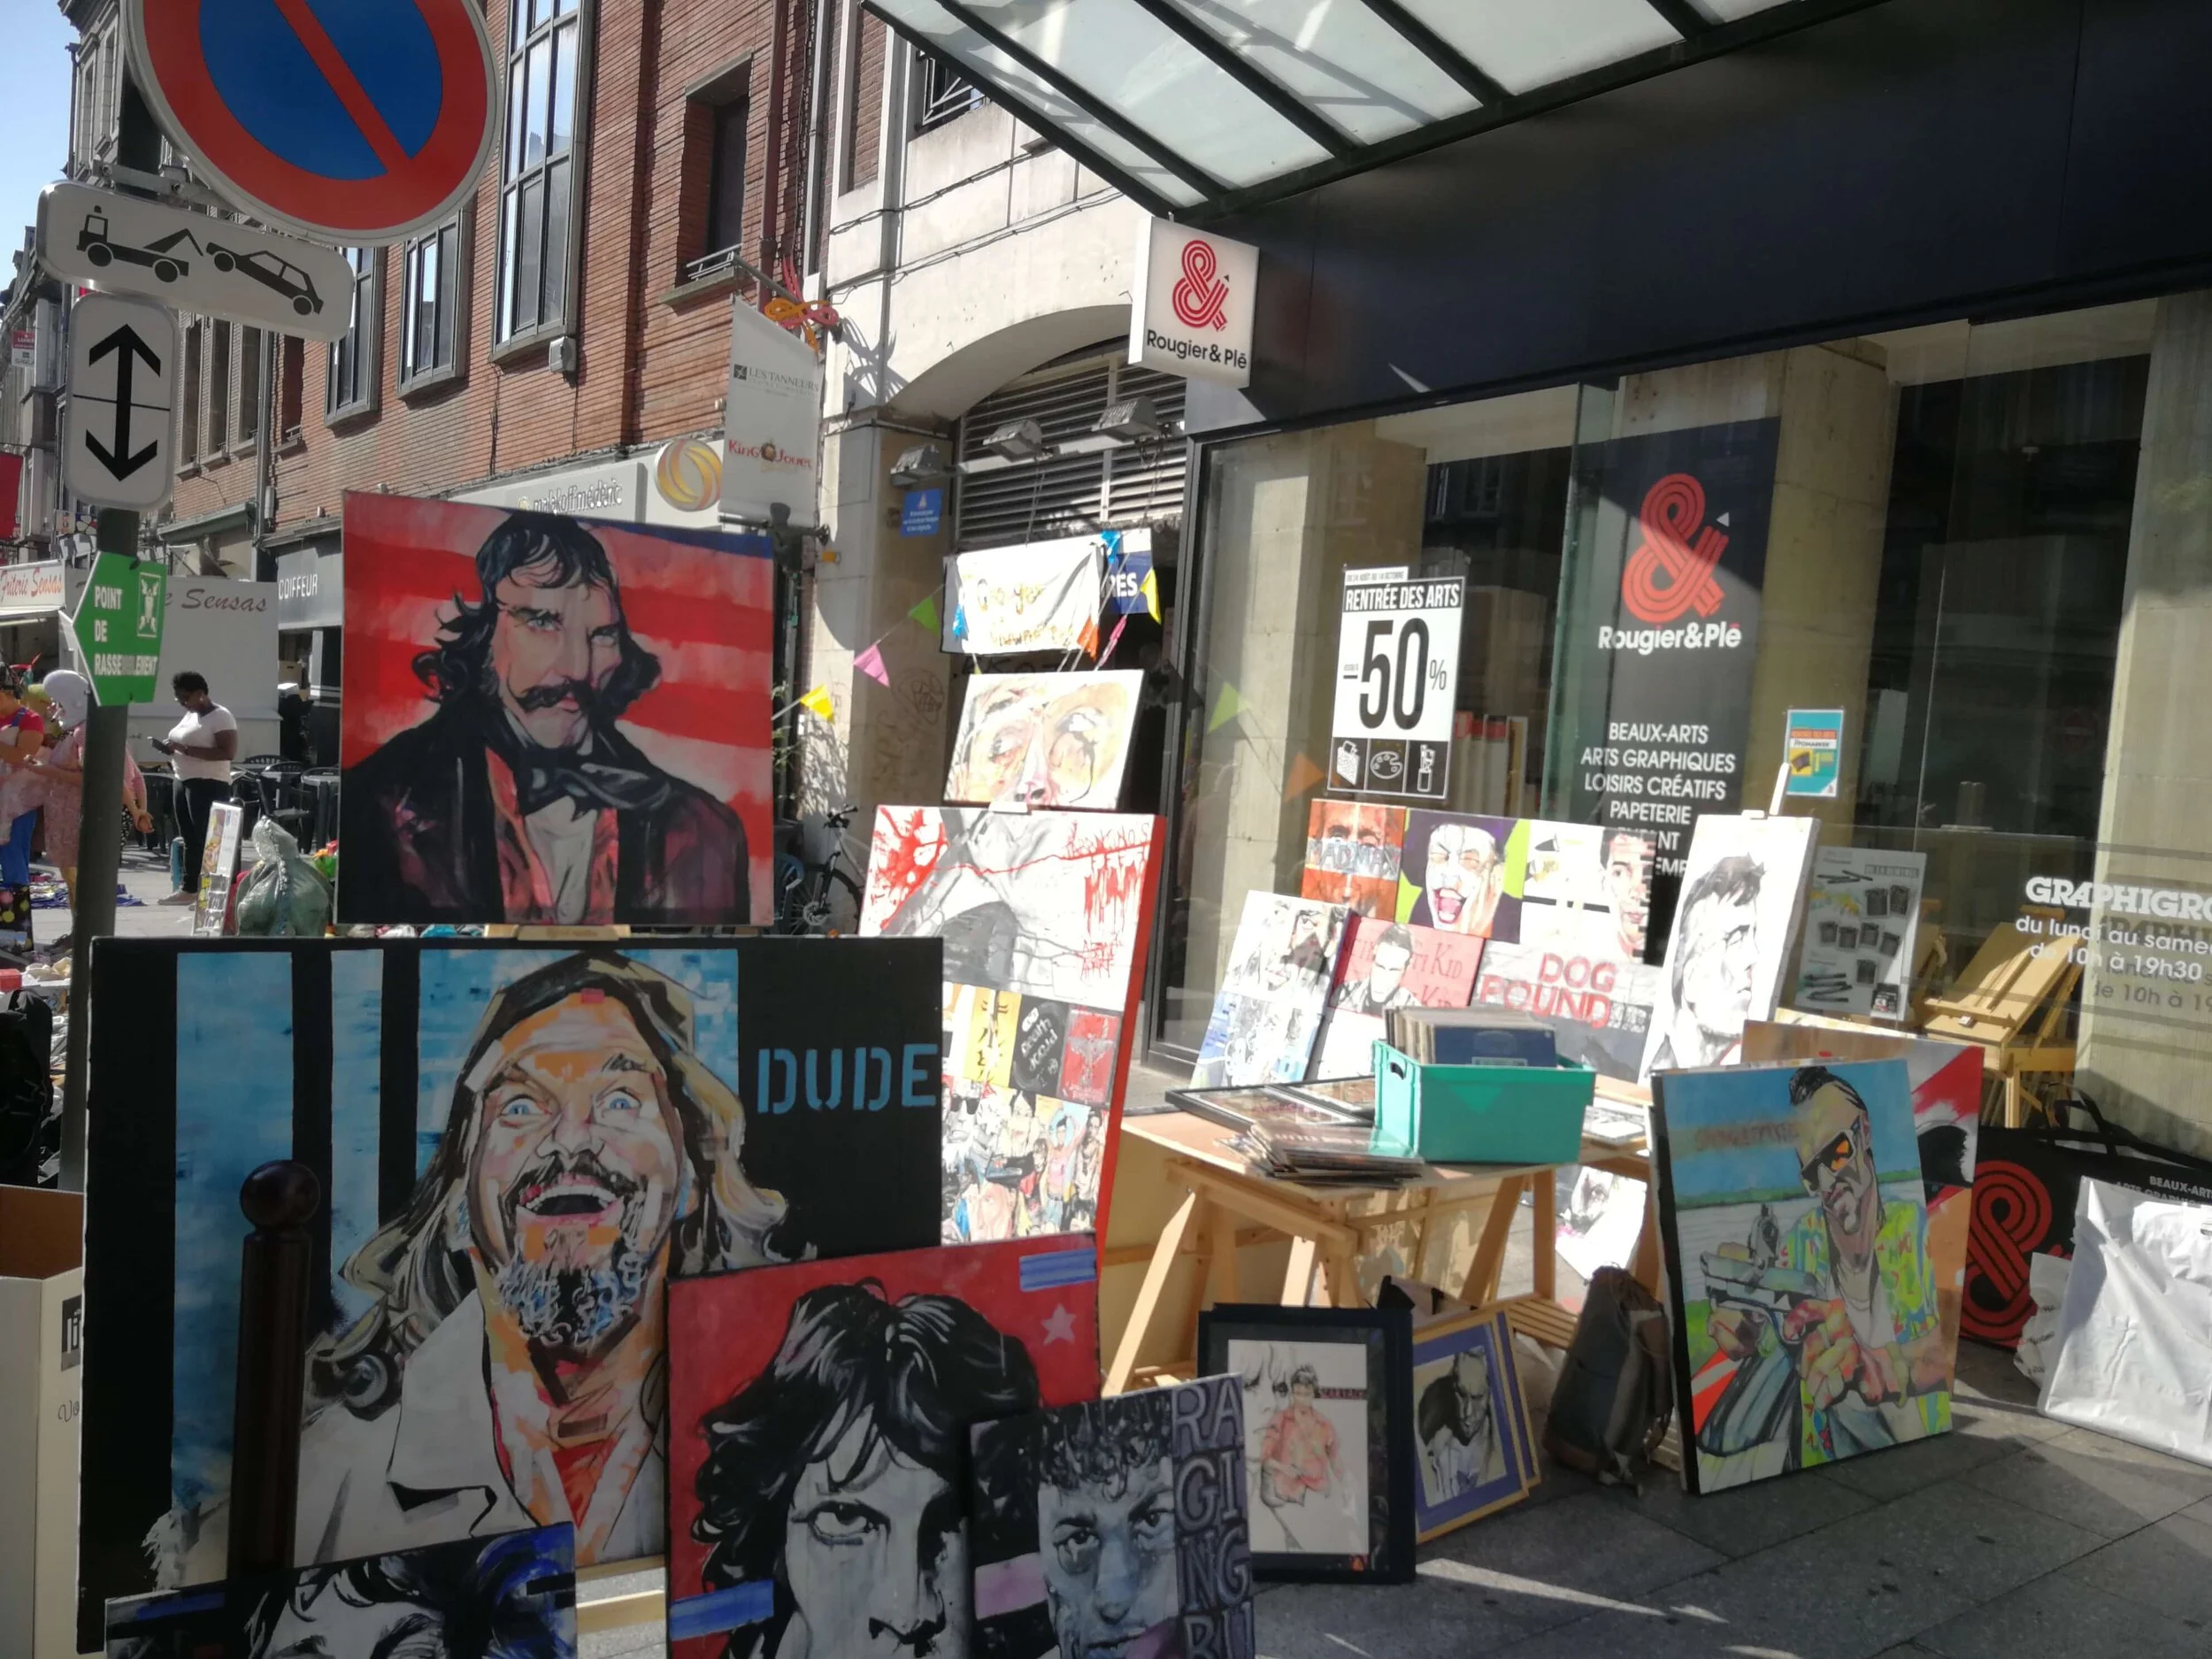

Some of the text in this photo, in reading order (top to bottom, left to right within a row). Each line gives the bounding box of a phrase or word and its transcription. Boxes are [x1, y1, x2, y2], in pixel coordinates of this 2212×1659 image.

[94, 585, 123, 610] POINT
[181, 588, 267, 612] Sensas
[278, 572, 319, 601] COIFFEUR
[1345, 583, 1461, 611] RENTRÉE DES ARTS
[94, 619, 108, 642] DE
[1609, 722, 1709, 745] BEAUX-ARTS
[1580, 747, 1736, 773] ARTS GRAPHIQUES
[1584, 772, 1727, 801] LOISIRS CRÉATIFS
[1609, 800, 1692, 825] PAPETERIE
[2016, 915, 2042, 933] du
[2049, 917, 2101, 942] lundi
[2108, 928, 2138, 947] au
[1539, 952, 1617, 994] DOG
[2066, 946, 2102, 967] 10h
[2109, 951, 2125, 972] à
[2133, 955, 2202, 981] 19h30
[757, 1044, 939, 1115] DUDE
